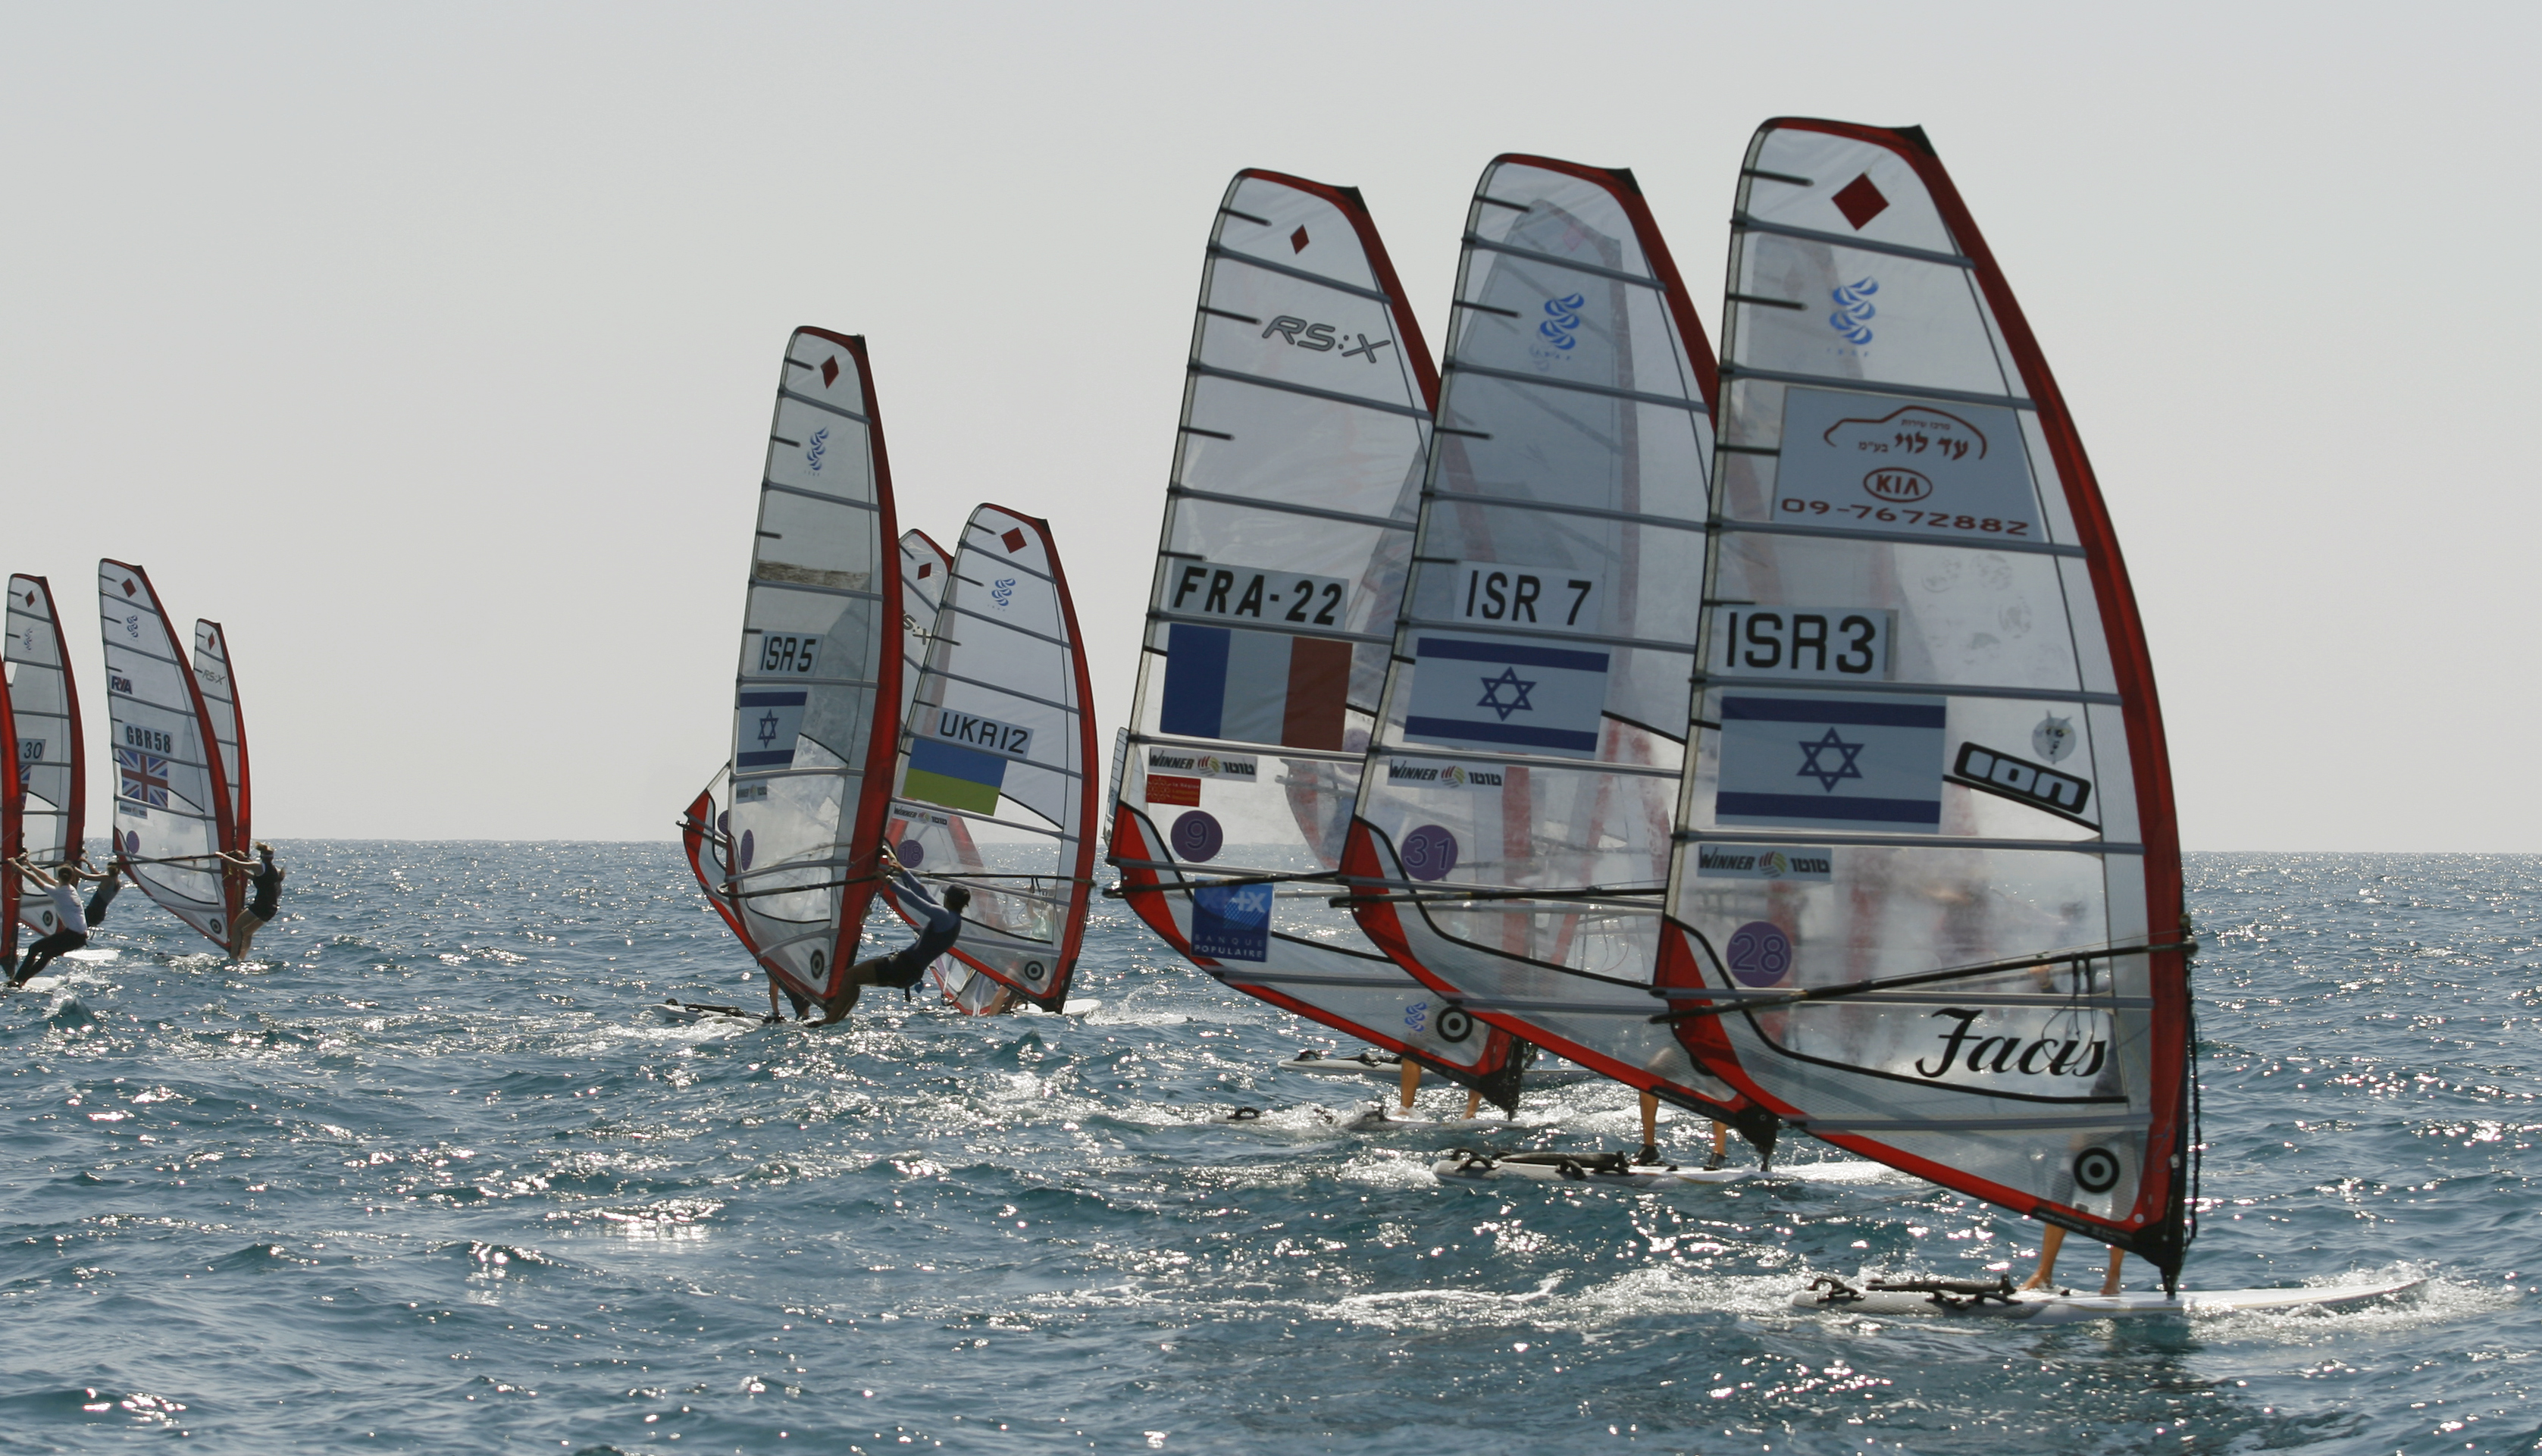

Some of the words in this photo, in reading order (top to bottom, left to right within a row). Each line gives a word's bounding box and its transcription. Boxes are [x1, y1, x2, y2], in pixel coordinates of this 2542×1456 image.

[1262, 315, 1391, 364] RS:X
[1876, 474, 1920, 496] KIA
[1781, 498, 2029, 537] 09-7672882
[1173, 565, 1342, 626] FRA-22
[1466, 569, 1541, 623] ISR
[1566, 579, 1592, 626] 7
[111, 675, 133, 694] RYA
[23, 741, 42, 759] 30
[1186, 819, 1208, 850] 9
[901, 844, 923, 862] 18
[1404, 835, 1451, 871] 31
[1194, 934, 1263, 947] BANQUE
[1194, 944, 1263, 958] POPULAIRE
[1731, 933, 1786, 974] 28
